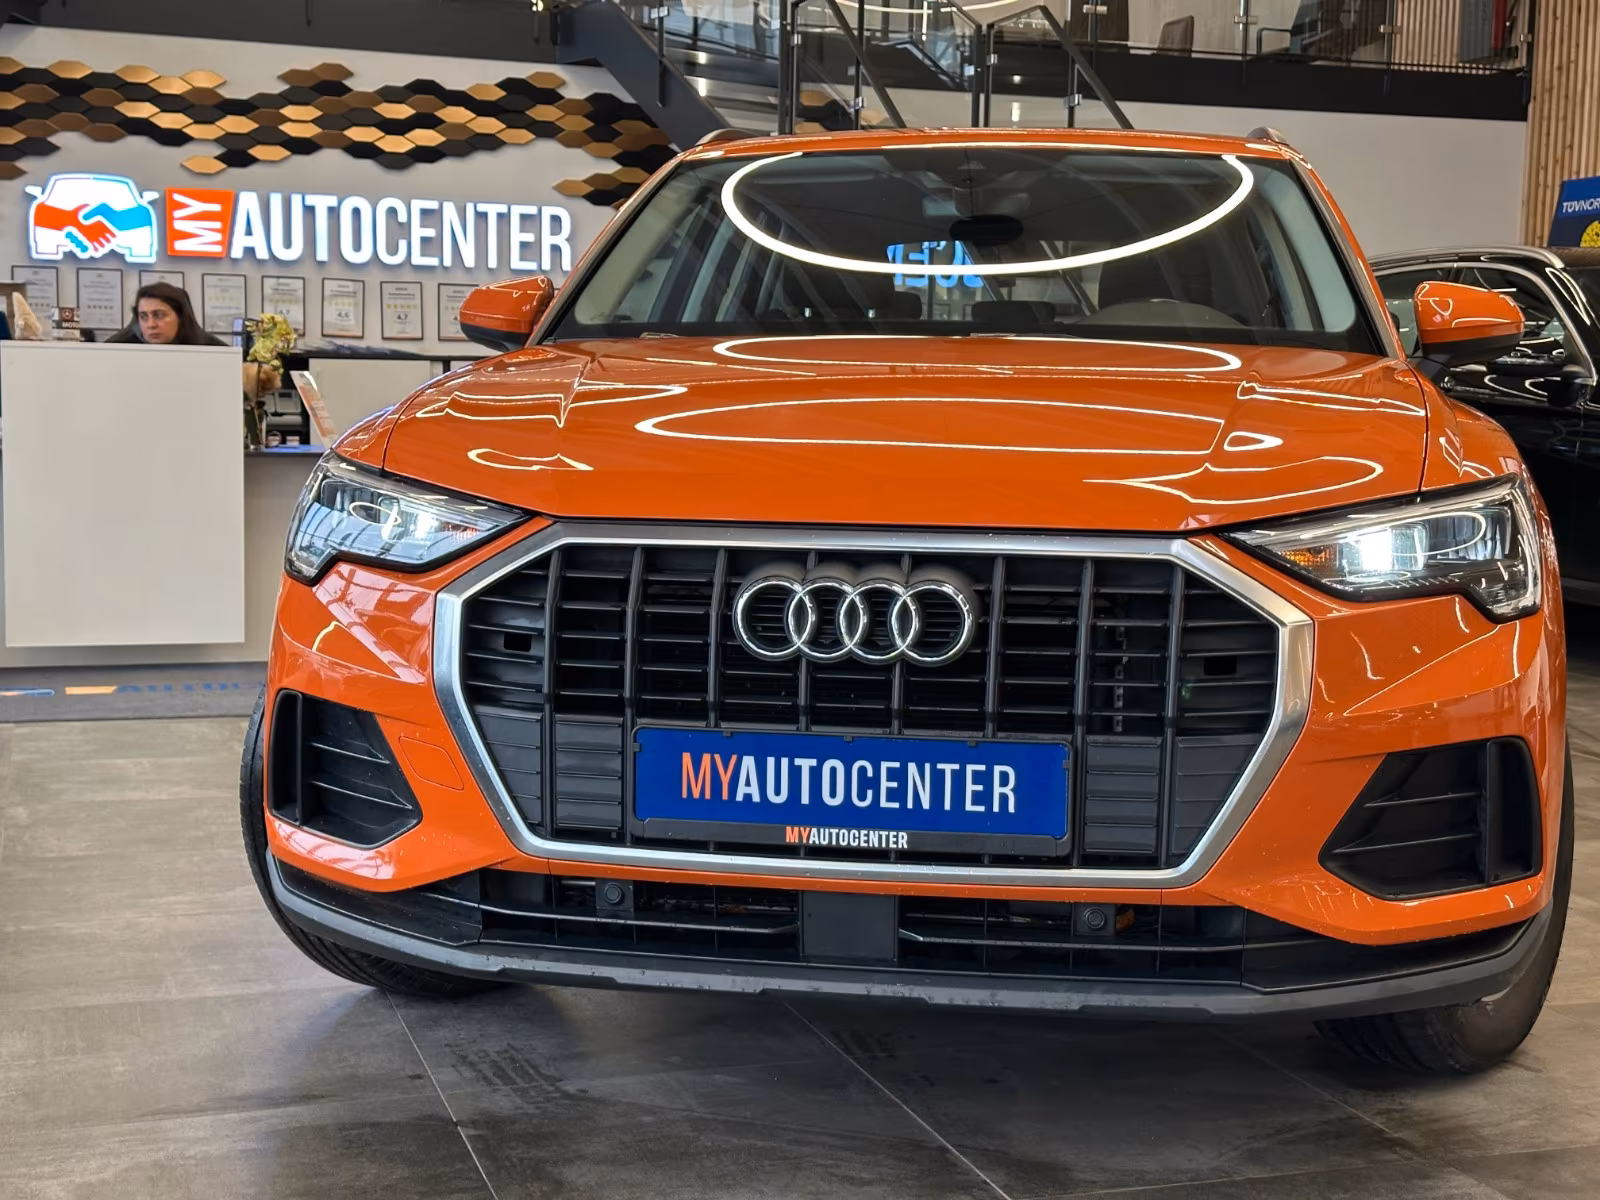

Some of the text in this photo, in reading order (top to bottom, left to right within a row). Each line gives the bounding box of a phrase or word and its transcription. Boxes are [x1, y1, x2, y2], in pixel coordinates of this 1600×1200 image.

[172, 191, 572, 271] MY AUTOCENTER
[681, 752, 1016, 813] MYAUTOCENTER
[785, 826, 908, 849] MYAUTOCENTER
